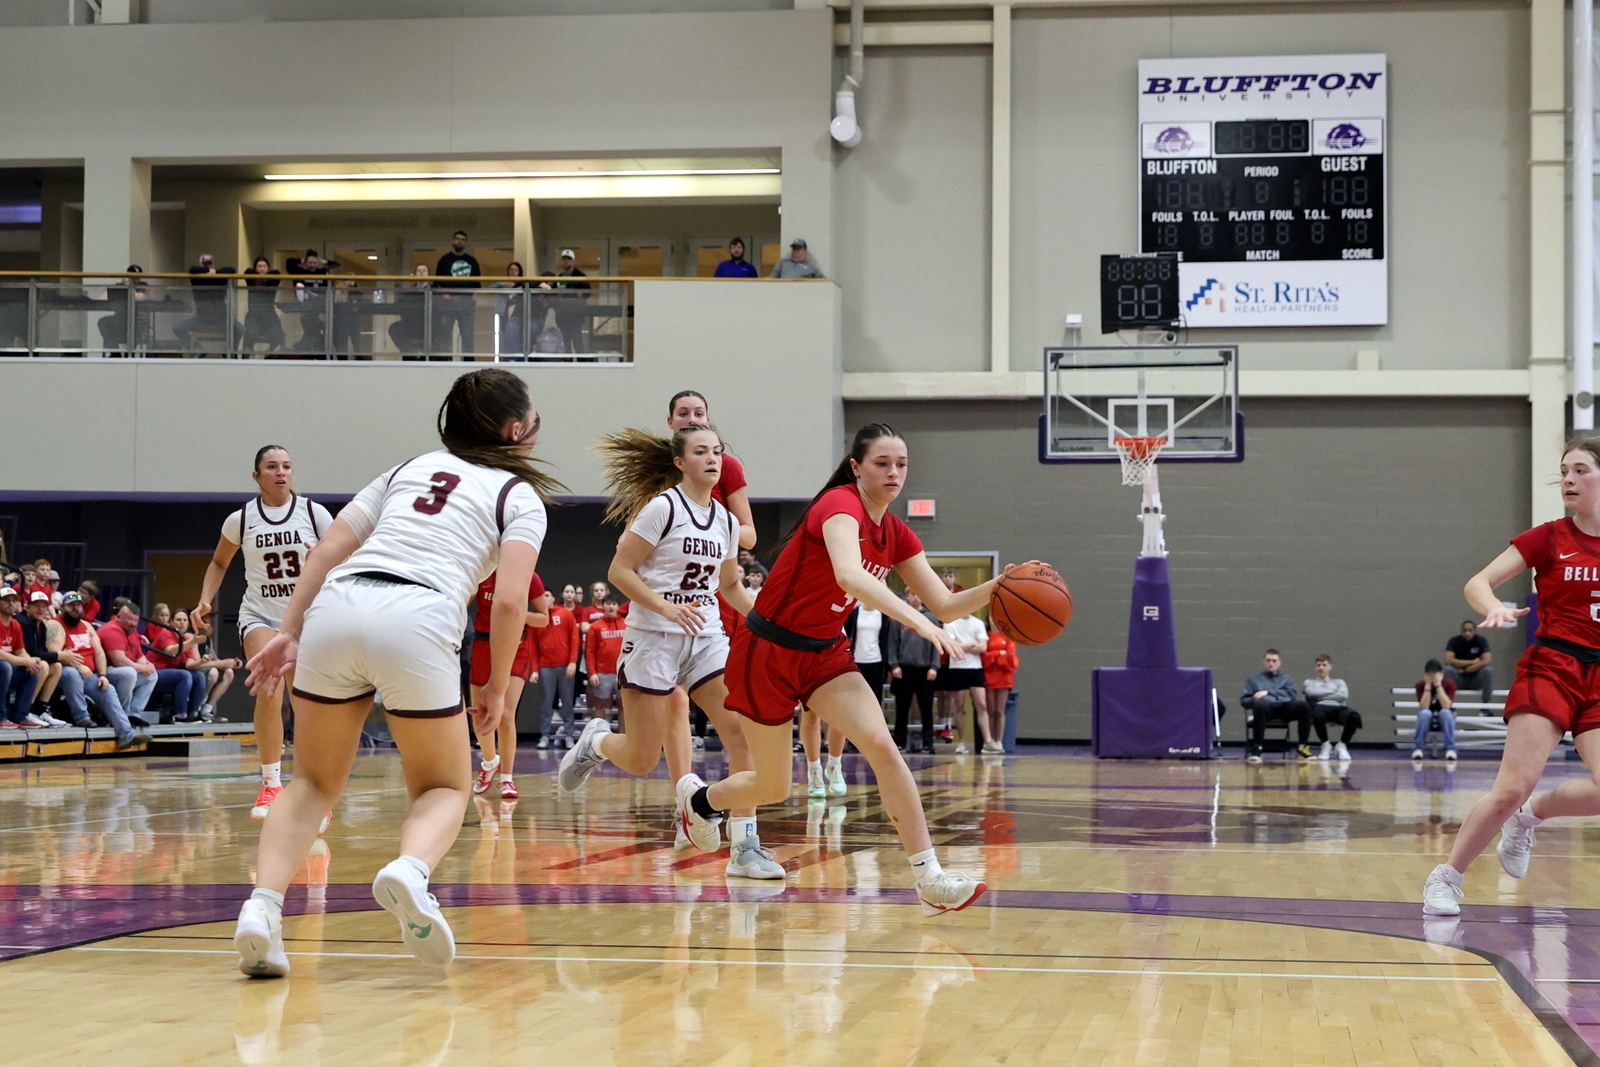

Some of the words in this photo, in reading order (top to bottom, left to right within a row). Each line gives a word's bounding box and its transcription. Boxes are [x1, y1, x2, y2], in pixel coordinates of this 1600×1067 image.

[1142, 73, 1383, 95] BLUFFTON
[1157, 91, 1354, 103] UNIVERSITY
[1147, 160, 1217, 175] BLUFFTON
[1321, 157, 1368, 172] GUEST
[1244, 166, 1279, 177] PERIOD
[1152, 211, 1183, 222] FOULS
[1193, 211, 1219, 221] T.O.L.
[1229, 210, 1265, 221] PLAYER
[1270, 210, 1294, 220] FOUL
[1304, 209, 1330, 220] T.O.L.
[1342, 208, 1373, 220] FOULS
[1246, 250, 1280, 261] MATCH
[1342, 248, 1374, 260] SCORE
[1234, 304, 1276, 313] HEALTH
[1281, 304, 1338, 313] PARTNERS
[413, 471, 461, 516] 3
[256, 530, 302, 548] GENOA
[682, 536, 722, 560] GENOA
[263, 550, 301, 580] 23
[680, 562, 715, 590] 22
